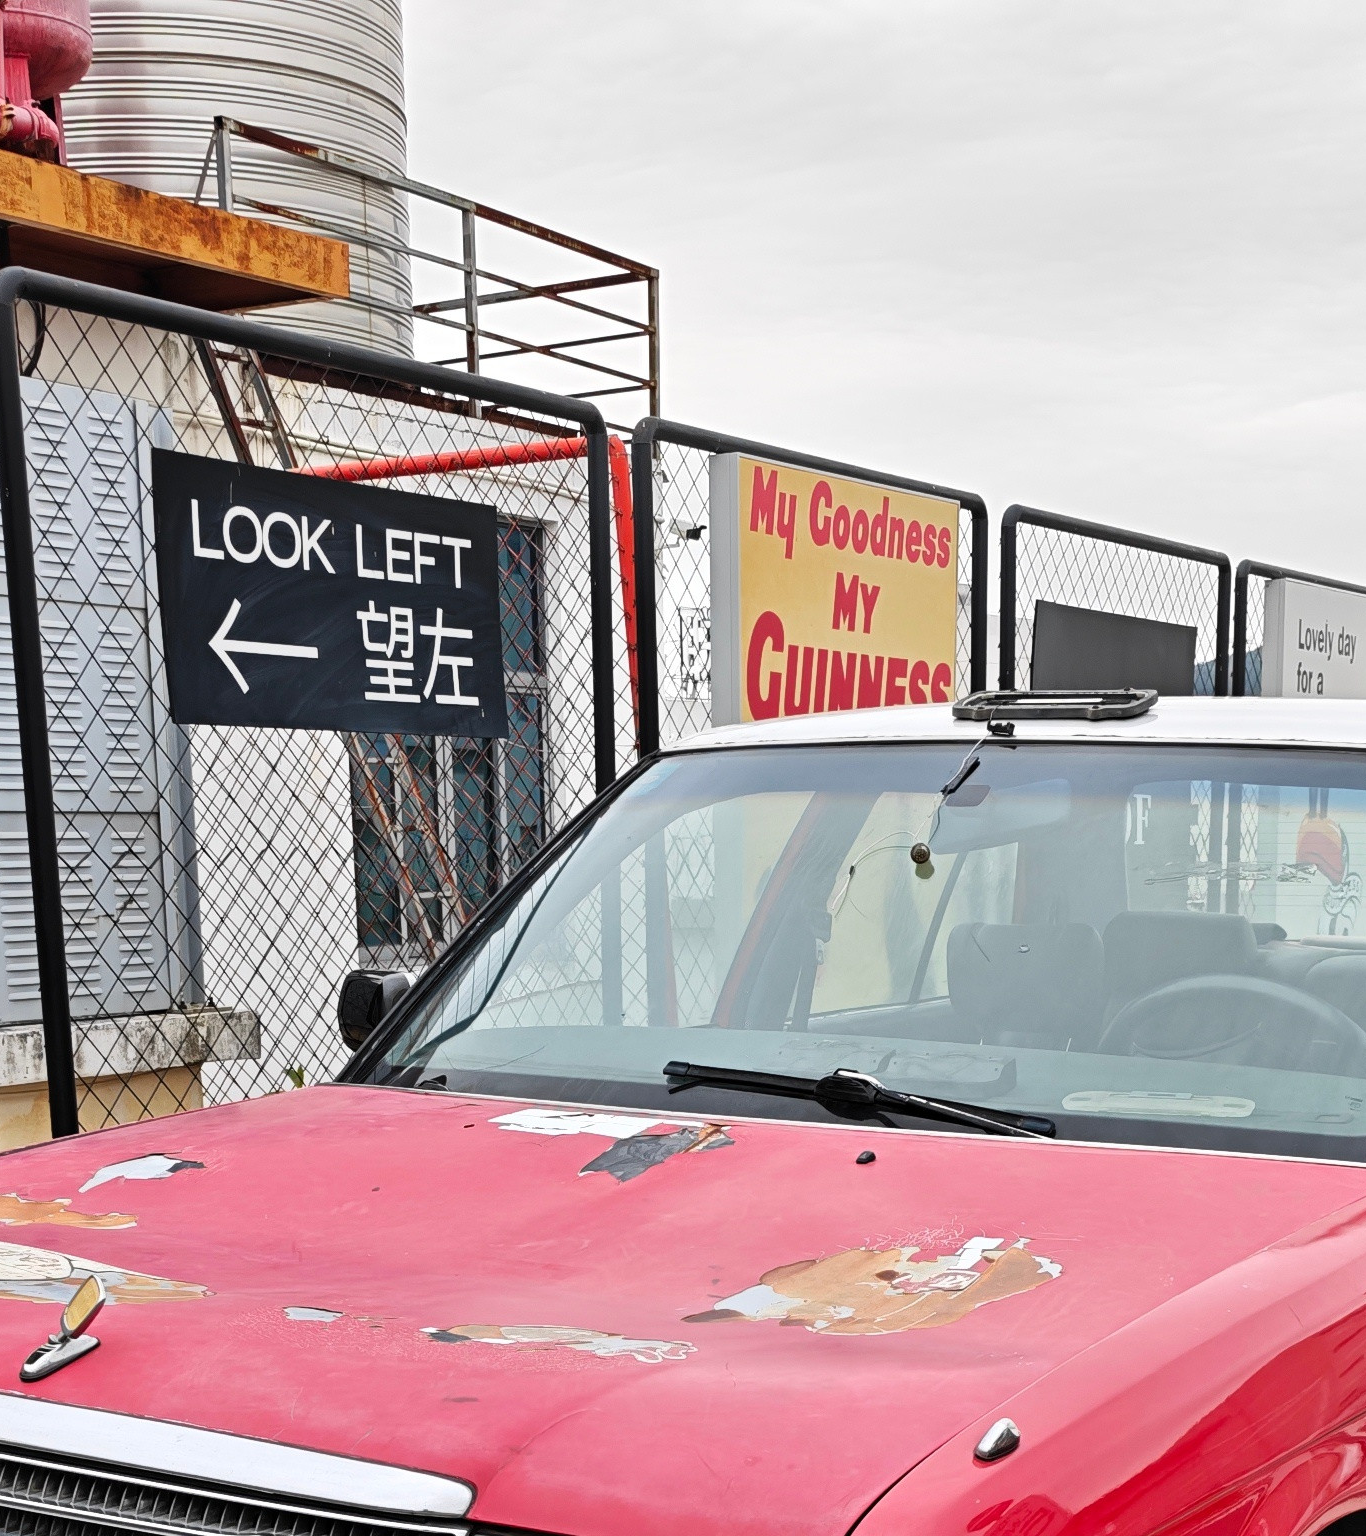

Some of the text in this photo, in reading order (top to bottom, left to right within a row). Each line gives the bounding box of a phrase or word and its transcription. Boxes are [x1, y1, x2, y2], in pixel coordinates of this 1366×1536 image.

[190, 498, 472, 589] LOOK LEFT
[750, 466, 951, 569] My Goodness
[832, 572, 880, 634] MY
[1297, 618, 1357, 664] Lovely day
[356, 600, 480, 706] 望左
[1296, 661, 1324, 695] for a
